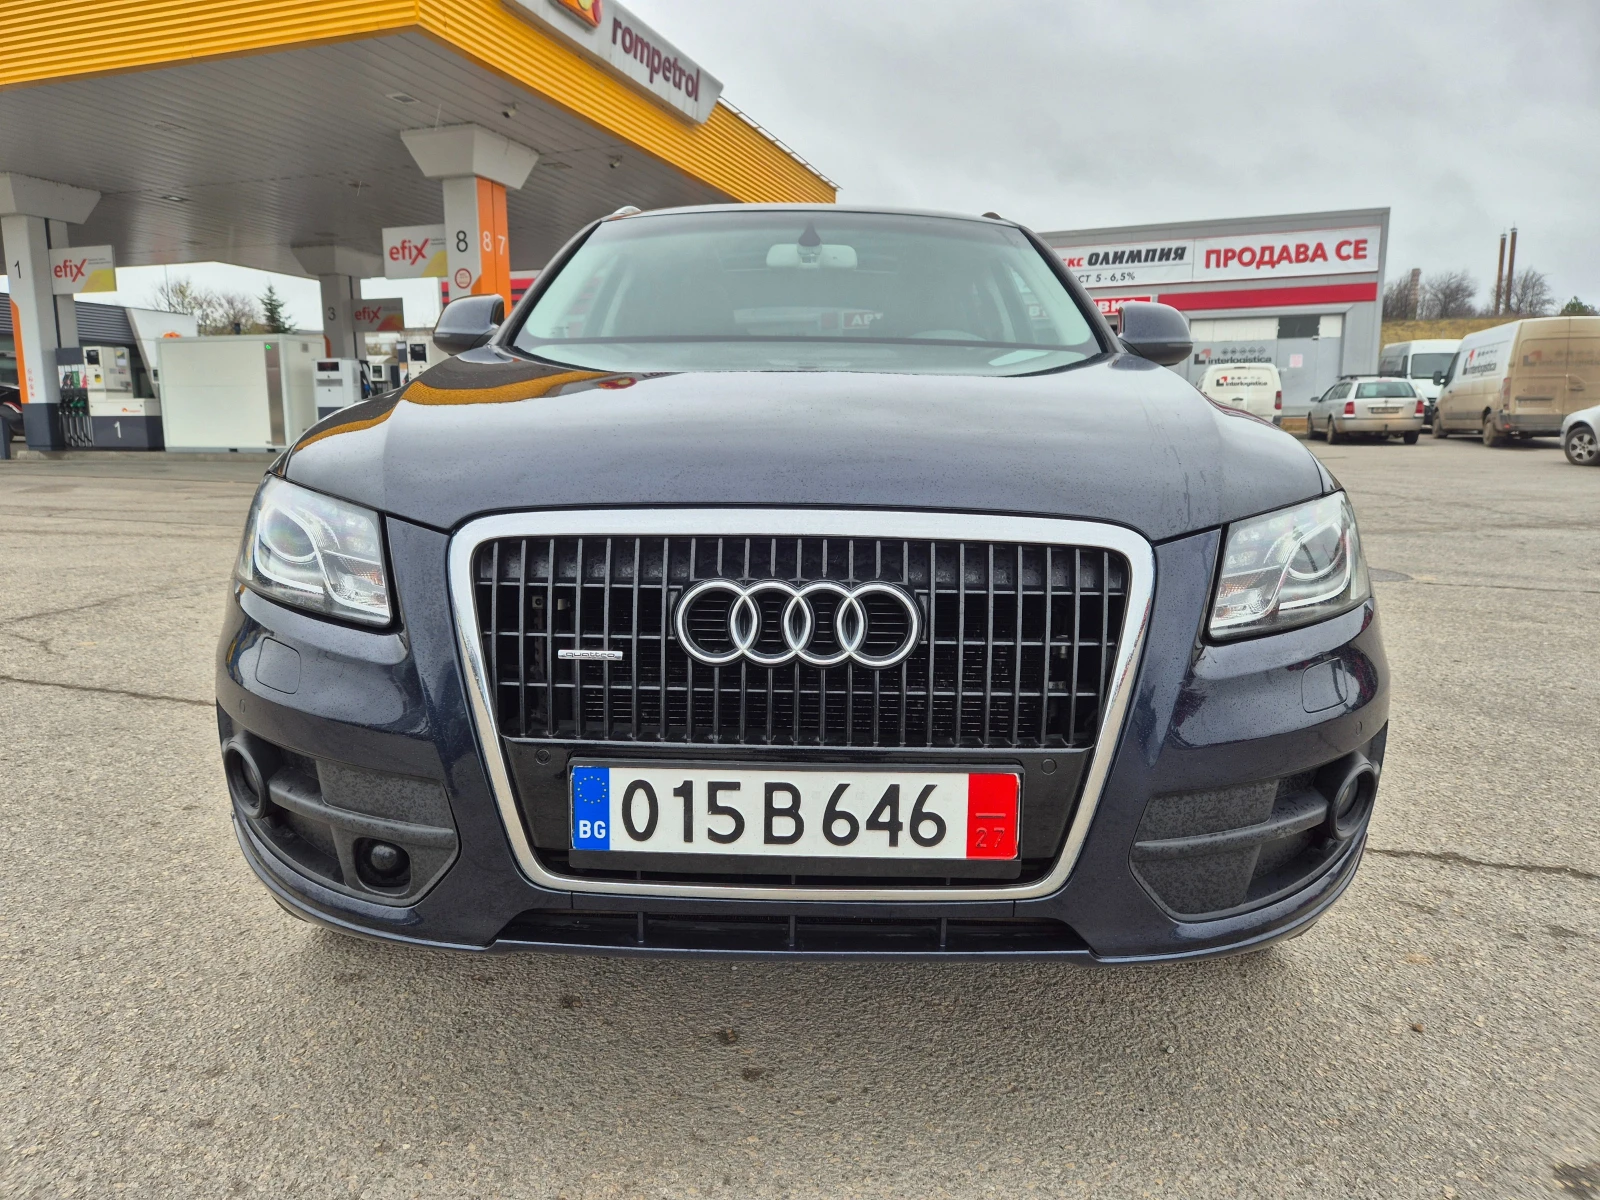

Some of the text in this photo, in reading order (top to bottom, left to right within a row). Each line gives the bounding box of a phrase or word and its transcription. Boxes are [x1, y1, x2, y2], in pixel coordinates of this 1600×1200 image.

[612, 17, 700, 101] rompetrol
[456, 230, 468, 253] 8
[483, 230, 492, 252] 8
[498, 235, 506, 255] 7
[389, 238, 430, 266] efix
[1087, 246, 1187, 267] ОЛИМПИЯ
[1205, 239, 1368, 270] ПРОДАВА СЕ
[14, 260, 22, 279] 1
[53, 258, 87, 283] efix
[1095, 273, 1102, 283] 5
[1110, 272, 1136, 283] 6,5%
[327, 306, 337, 321] 3
[354, 305, 382, 324] efix
[113, 420, 122, 439] 1
[579, 820, 606, 839] BG
[975, 827, 1005, 849] 27
